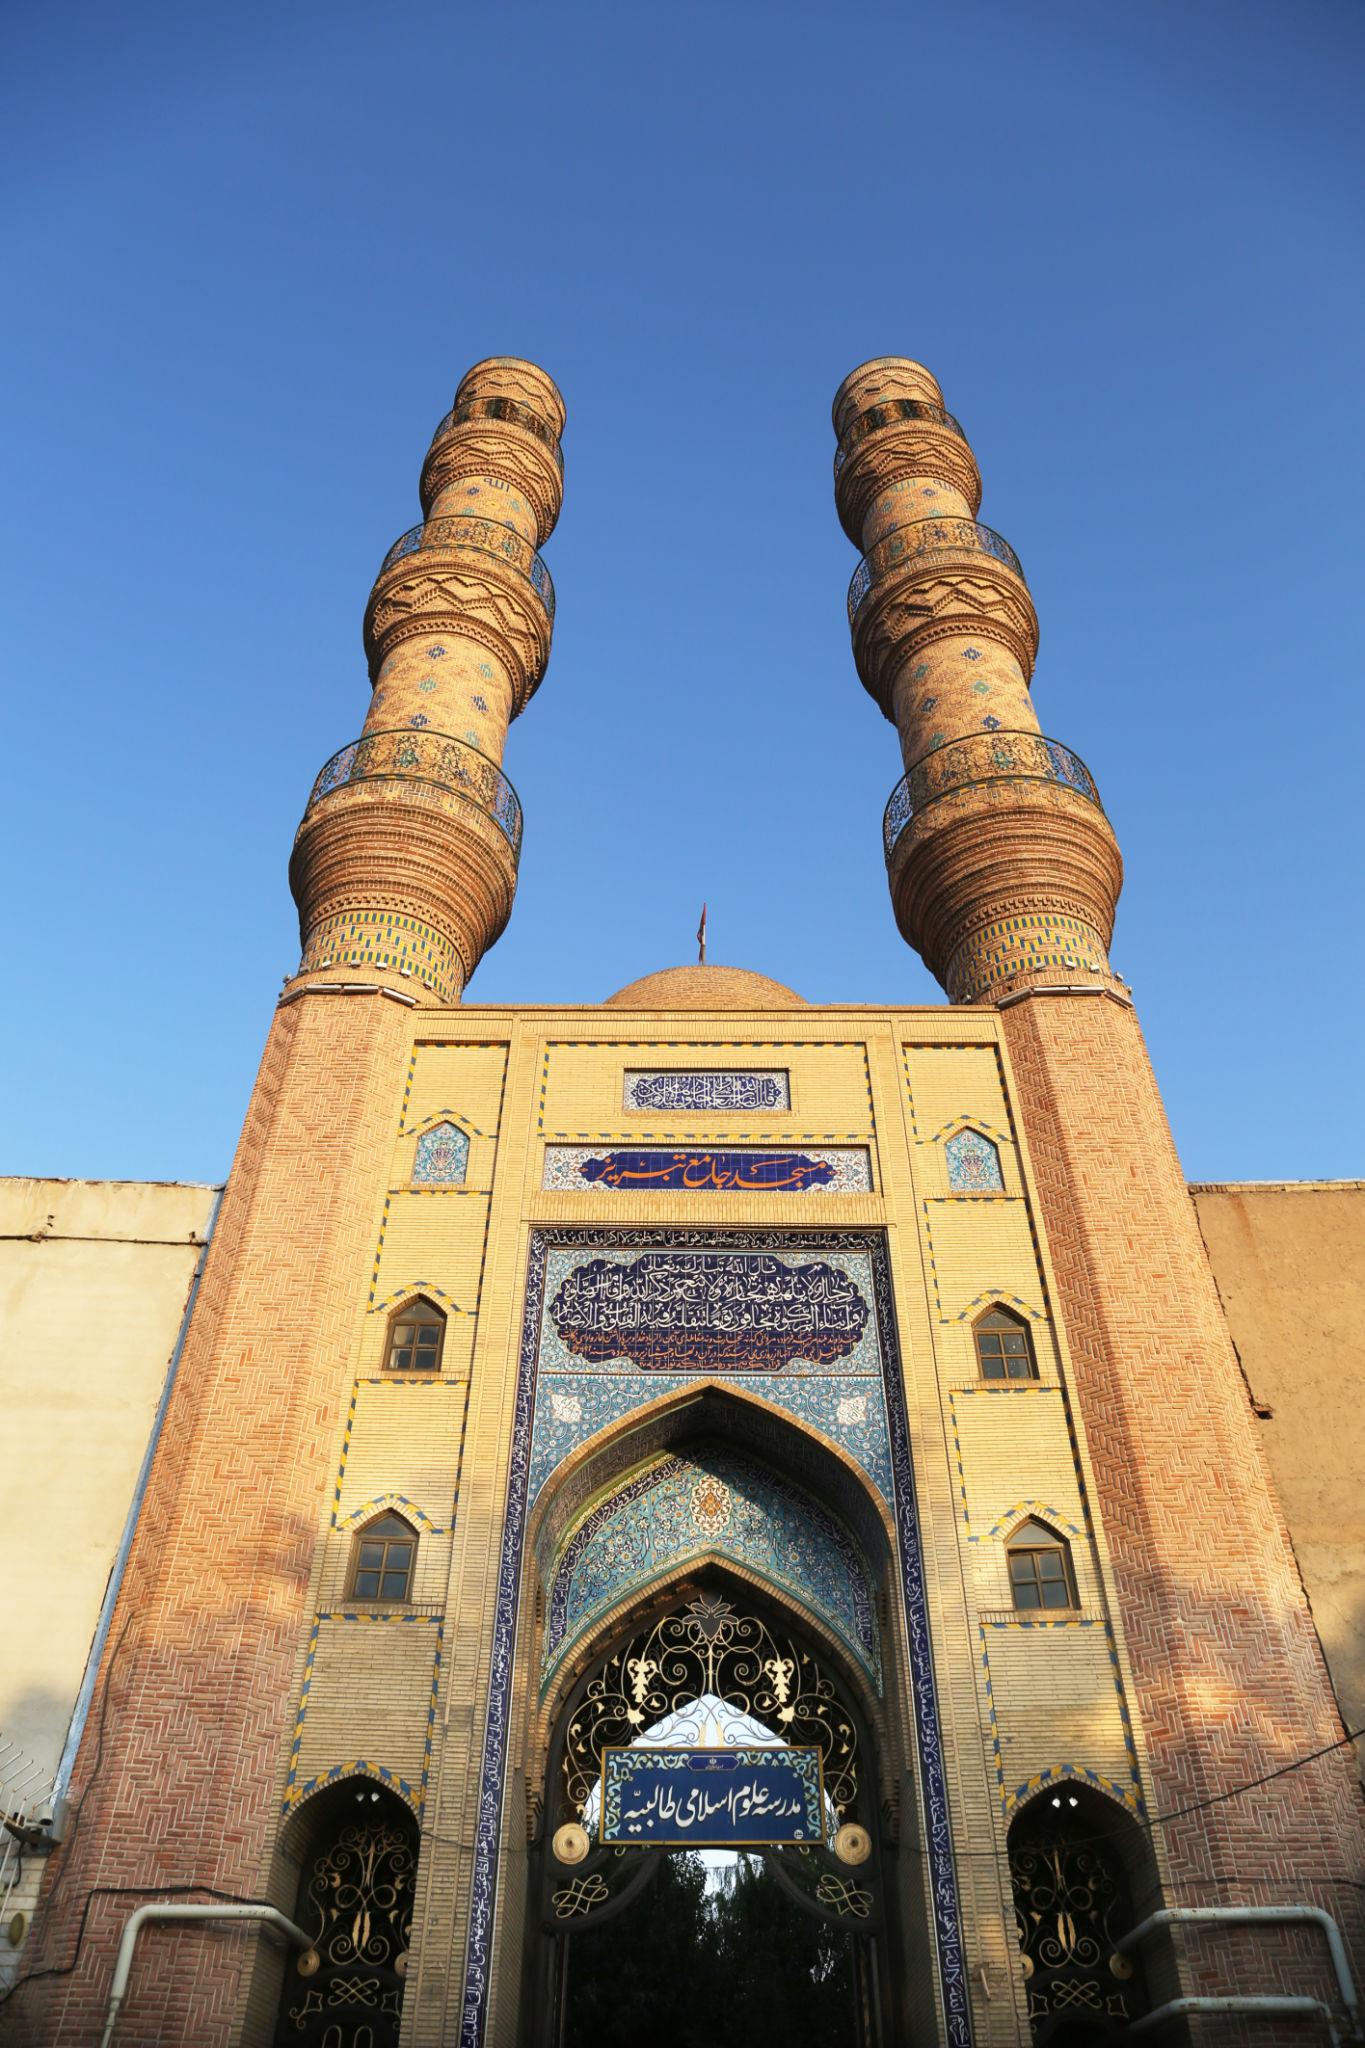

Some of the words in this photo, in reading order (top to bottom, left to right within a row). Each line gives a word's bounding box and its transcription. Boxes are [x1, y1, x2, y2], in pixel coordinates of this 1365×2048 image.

[484, 478, 510, 492] الله
[597, 1153, 688, 1185] تبریز
[683, 1154, 731, 1189] جامع
[729, 1158, 828, 1189] مسجد
[726, 1256, 747, 1274] الله
[748, 1256, 777, 1275] قال
[675, 1787, 734, 1827] اسلامی
[732, 1780, 770, 1826] علوم
[752, 1795, 801, 1817] مدرسه
[946, 1986, 966, 2011] الله
